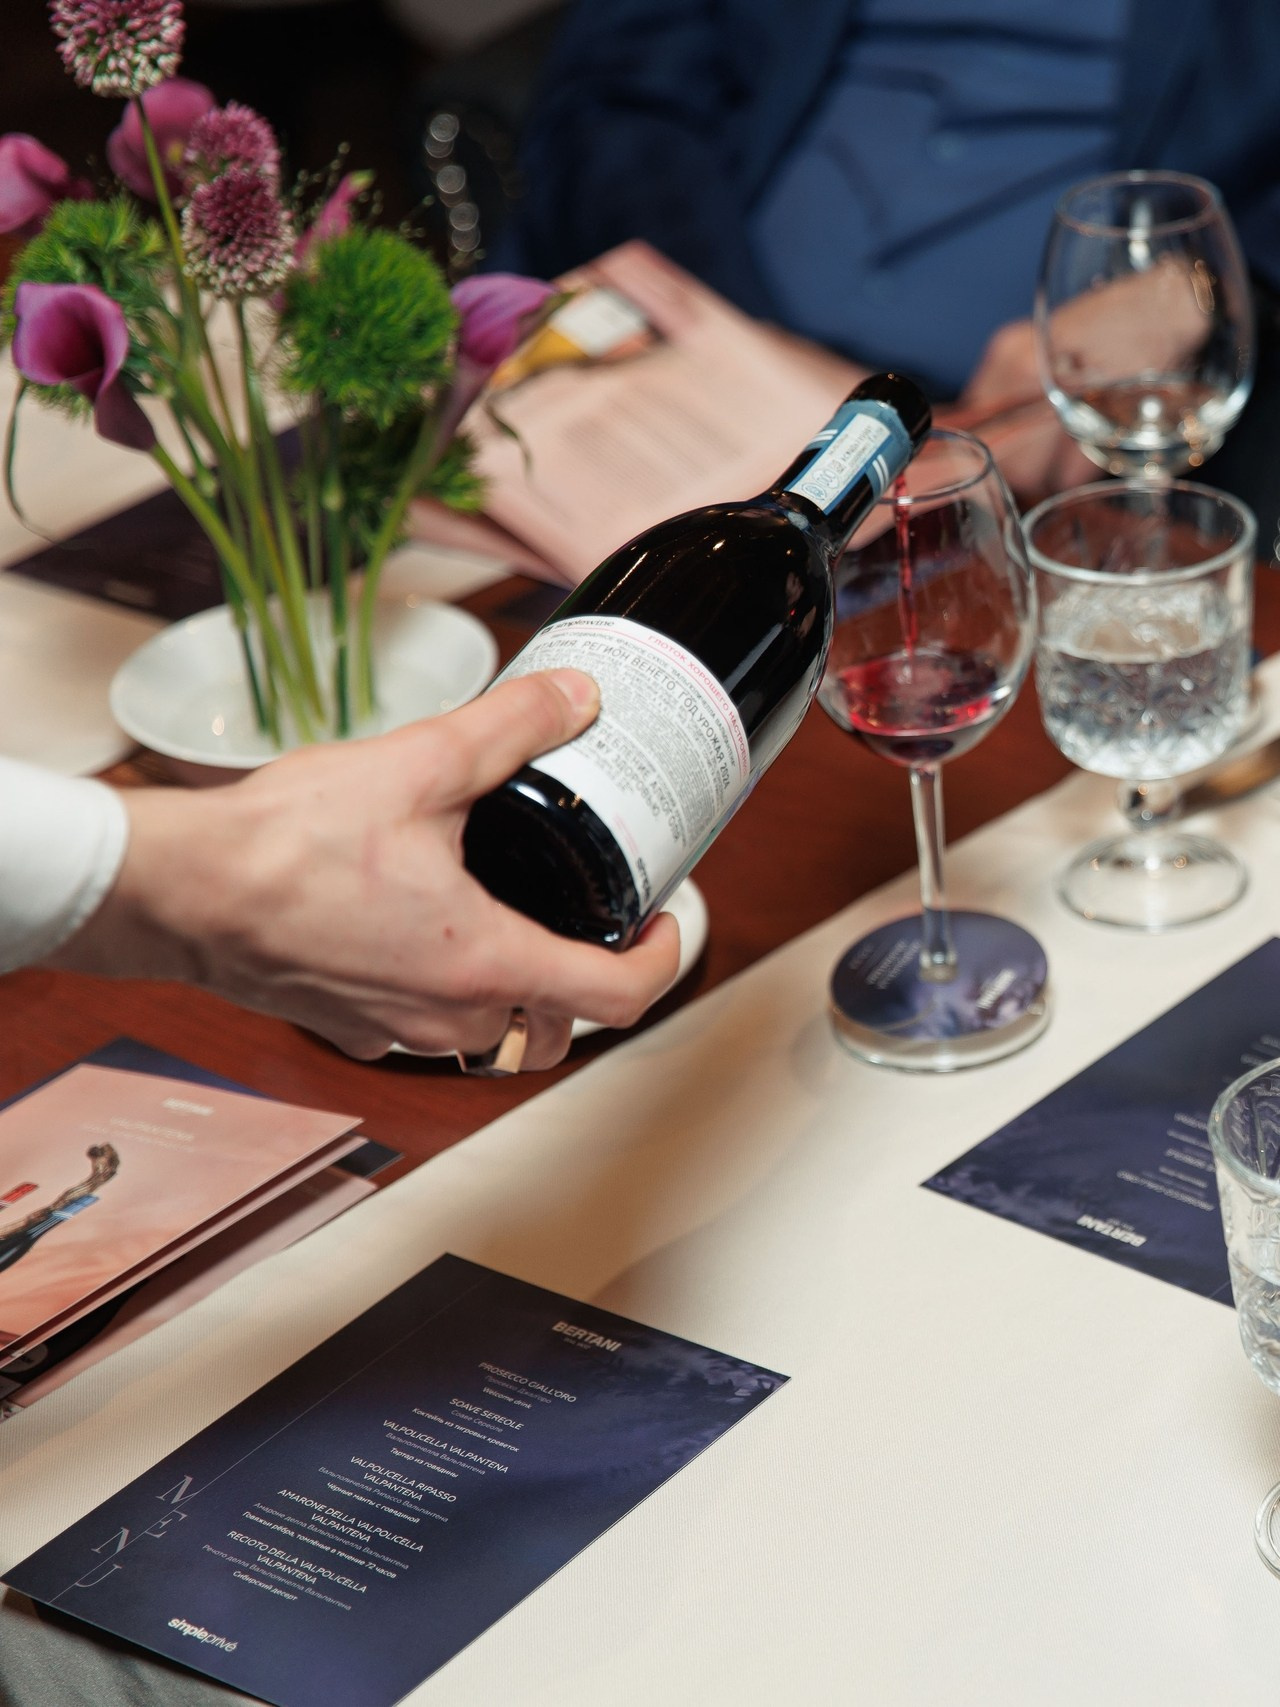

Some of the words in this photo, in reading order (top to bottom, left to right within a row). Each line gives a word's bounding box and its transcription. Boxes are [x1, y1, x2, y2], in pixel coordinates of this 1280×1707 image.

[647, 635, 688, 663] ГЛОТОК
[688, 661, 730, 713] ХОРОШЕГО
[582, 641, 630, 661] РЕГИОН
[678, 691, 700, 716] ГОД
[697, 713, 725, 764] УРОЖАЯ
[550, 1319, 622, 1353] BERTANI
[477, 1361, 528, 1385] PROSECCO
[527, 1380, 577, 1403] GIALL'ORO
[482, 1387, 514, 1402] Welcome
[513, 1399, 532, 1409] drink
[411, 1407, 445, 1423] Коктейль
[453, 1424, 487, 1440] тигровых
[486, 1437, 519, 1453] креветок
[449, 1398, 482, 1414] SOAVE
[479, 1409, 524, 1430] SEREOLE
[450, 1409, 473, 1421] Соаве
[472, 1418, 504, 1433] Сереоле
[382, 1420, 448, 1449] VALPOLICELLA
[448, 1445, 508, 1473] VALPANTENA
[384, 1432, 440, 1456] Вальполичелла
[439, 1453, 486, 1474] Вальпантена
[389, 1448, 415, 1460] Тартар
[423, 1461, 458, 1478] говядины
[317, 1466, 372, 1491] Вальполичелла
[373, 1489, 403, 1503] Рипассо
[401, 1501, 449, 1522] Вальпантена
[349, 1456, 415, 1486] VALPOLICELLA
[414, 1482, 457, 1502] RIPASSO
[362, 1473, 423, 1500] VALPANTENA
[276, 1488, 327, 1512] AMARONE
[324, 1507, 356, 1524] DELLA
[355, 1520, 424, 1551] VALPOLICELLA
[325, 1483, 353, 1496] Чёрные
[352, 1494, 376, 1505] манты
[380, 1505, 420, 1523] говядиной
[241, 1511, 273, 1527] Говяжьи
[271, 1523, 297, 1537] рёбра,
[294, 1533, 331, 1551] томлёные
[335, 1550, 365, 1565] течение
[374, 1566, 397, 1578] часов
[252, 1502, 286, 1519] Амароне
[285, 1516, 307, 1528] делла
[306, 1524, 363, 1550] Вальполичелла
[361, 1547, 409, 1569] Вальпантена
[310, 1514, 371, 1541] VALPANTENA
[201, 1545, 228, 1558] Речото
[225, 1555, 250, 1567] делла
[248, 1564, 305, 1590] Вальполичелла
[303, 1587, 352, 1610] Вальпантена
[225, 1530, 269, 1551] RECIOTO
[266, 1547, 298, 1563] DELLA
[298, 1561, 367, 1592] VALPOLICELLA
[255, 1555, 317, 1583] VALPANTENA
[231, 1570, 274, 1590] Сибирский
[270, 1587, 298, 1601] десерт
[165, 1616, 239, 1653] simpleprivé
